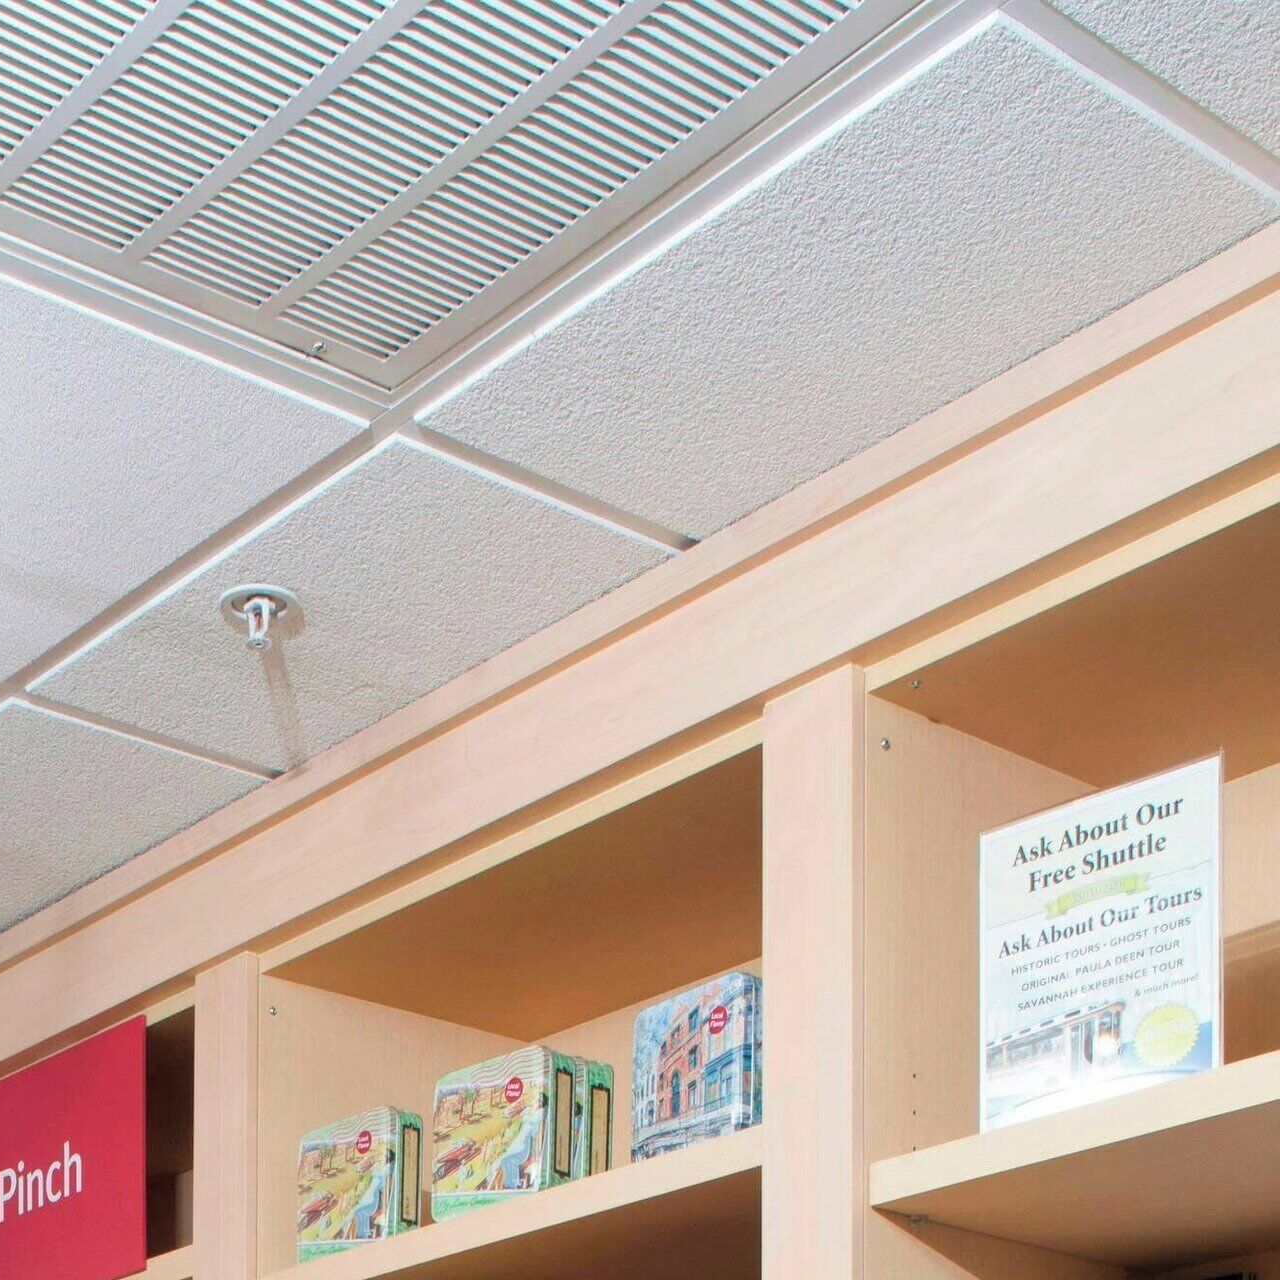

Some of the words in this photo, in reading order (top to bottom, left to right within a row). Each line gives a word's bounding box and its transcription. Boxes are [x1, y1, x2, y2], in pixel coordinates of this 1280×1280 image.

[1013, 837, 1053, 867] Ask
[1058, 813, 1128, 852] About
[1136, 798, 1183, 826] Our
[1028, 865, 1076, 893] Free
[1082, 833, 1167, 875] Shuttle
[998, 934, 1031, 959] Ask
[1036, 916, 1094, 947] About
[1100, 906, 1139, 928] Our
[1144, 886, 1202, 915] Tours
[1011, 955, 1061, 976] HISTORIC
[1065, 942, 1100, 963] TOURS
[1109, 928, 1148, 948] GHOST
[1152, 916, 1191, 935] TOURS
[1017, 988, 1078, 1012] SAVANNAH
[1081, 968, 1148, 994] EXPERIENCE
[1152, 958, 1184, 974] TOUR
[1021, 971, 1071, 992] ORIGINAL
[1075, 959, 1111, 976] PAULA
[1115, 950, 1145, 965] DEEN
[1149, 939, 1180, 956] TOUR
